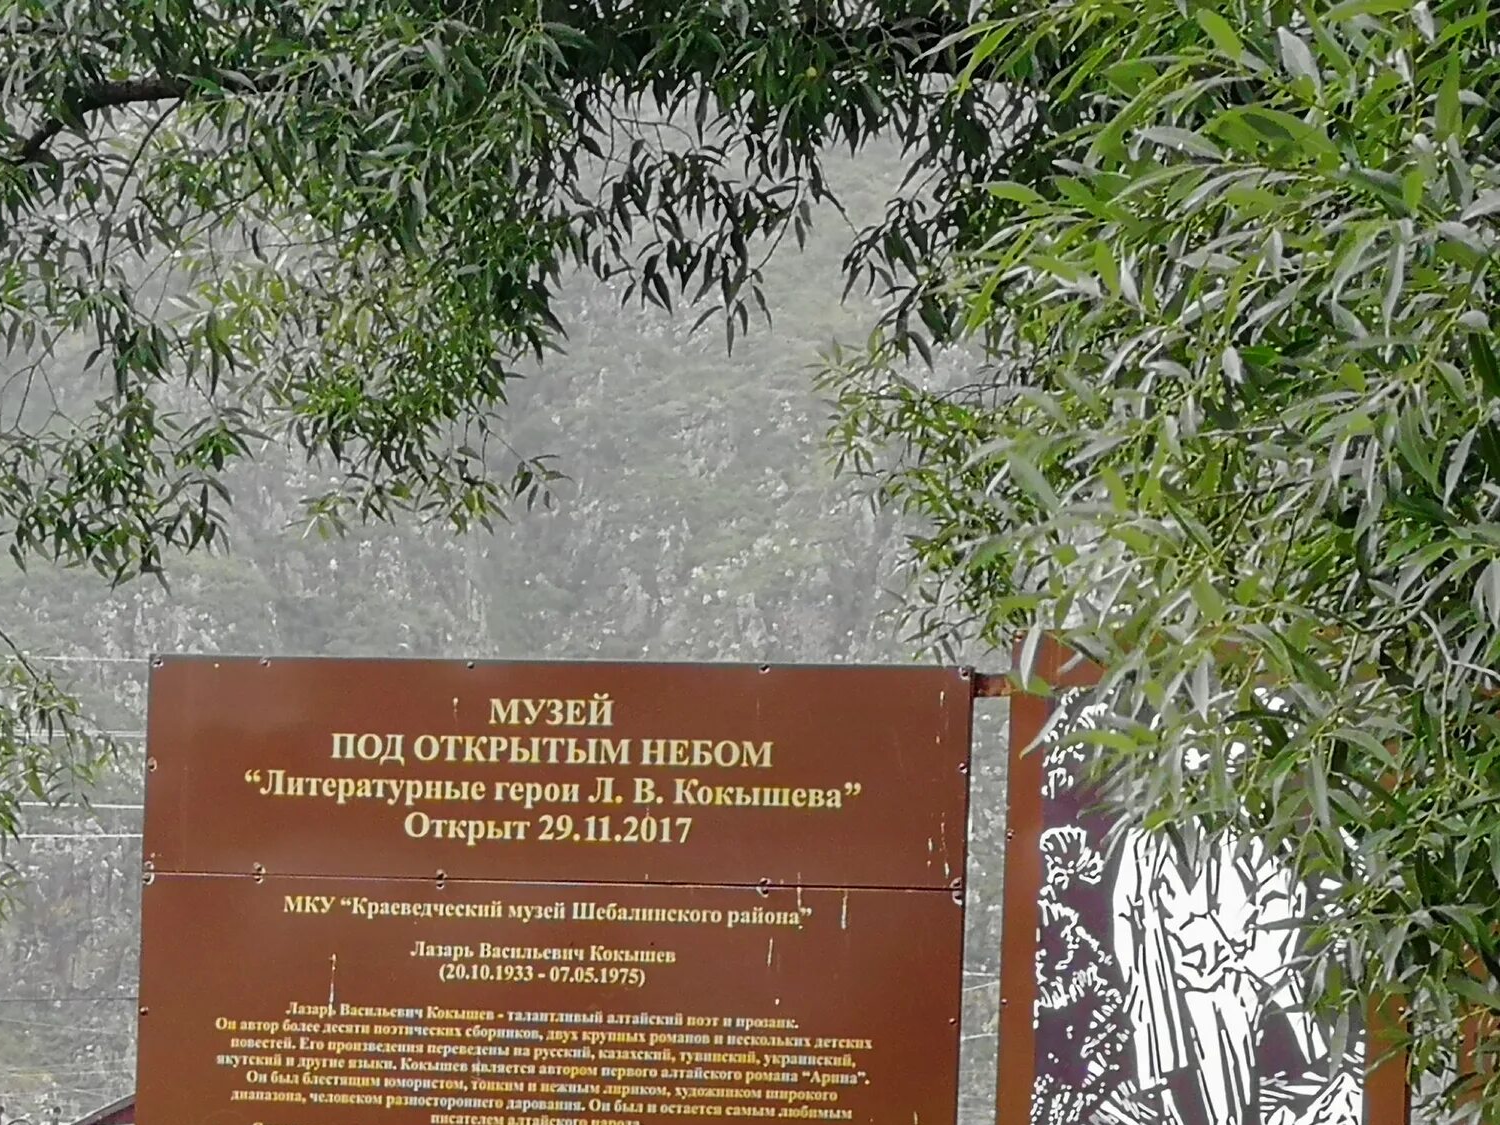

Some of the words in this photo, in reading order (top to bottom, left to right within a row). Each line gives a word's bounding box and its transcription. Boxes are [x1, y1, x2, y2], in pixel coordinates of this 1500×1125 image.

[489, 689, 614, 726] МУЗЕЙ
[331, 733, 404, 767] ПОД
[414, 734, 631, 766] ОТКРЫТЫМ
[640, 739, 773, 768] НЕБОМ
[245, 767, 485, 808] “Литературные
[494, 781, 579, 810] герои
[588, 775, 622, 805] Л.
[633, 776, 663, 804] В.
[673, 777, 861, 809] Кокышева”
[405, 811, 530, 843] Открыт
[538, 814, 692, 844] 29.11.2017
[284, 892, 335, 913] МКУ
[341, 894, 502, 922] “Краеведческий
[509, 898, 565, 924] музей
[572, 900, 722, 924] Шебалинского
[410, 939, 474, 961] Лазарь
[480, 941, 584, 961] Васильевич
[590, 945, 676, 964] Кокышев
[439, 963, 533, 987] (20.10.1933
[550, 966, 645, 990] 07.05.1975)
[340, 1002, 423, 1018] Васильевич
[427, 1005, 494, 1020] Кокышев
[507, 1007, 603, 1024] талантливый
[607, 1010, 683, 1026] алтайский
[687, 1016, 719, 1027] поэт
[215, 1015, 236, 1030] Он
[240, 1019, 279, 1035] автор
[283, 1017, 320, 1033] более
[322, 1022, 370, 1037] десяти
[374, 1024, 461, 1037] поэтических
[546, 1029, 578, 1044] двух
[582, 1030, 645, 1046] крупных
[649, 1032, 710, 1048] романов
[727, 1035, 810, 1048] нескольких
[814, 1037, 872, 1052] детских
[300, 1035, 324, 1051] Его
[328, 1040, 423, 1057] произведения
[427, 1043, 509, 1060] переведены
[514, 1046, 530, 1057] на
[217, 1049, 281, 1070] якутский
[297, 1056, 345, 1072] другие
[401, 1055, 468, 1072] Кокышев
[472, 1062, 535, 1075] является
[539, 1064, 597, 1080] автором
[601, 1066, 657, 1082] первого
[661, 1064, 742, 1081] алтайского
[746, 1070, 798, 1086] романа
[246, 1068, 267, 1084] Он
[271, 1069, 299, 1085] был
[302, 1070, 380, 1090] блестящим
[471, 1080, 524, 1092] тонким
[540, 1082, 600, 1095] нежным
[675, 1086, 762, 1103] художником
[766, 1089, 837, 1106] широкого
[310, 1092, 382, 1105] человеком
[386, 1095, 503, 1111] разностороннего
[589, 1098, 610, 1112] Он
[614, 1099, 643, 1113] был
[647, 1103, 656, 1114] и
[660, 1104, 721, 1116] остается
[725, 1106, 775, 1118] самым
[778, 1104, 852, 1120] любимым
